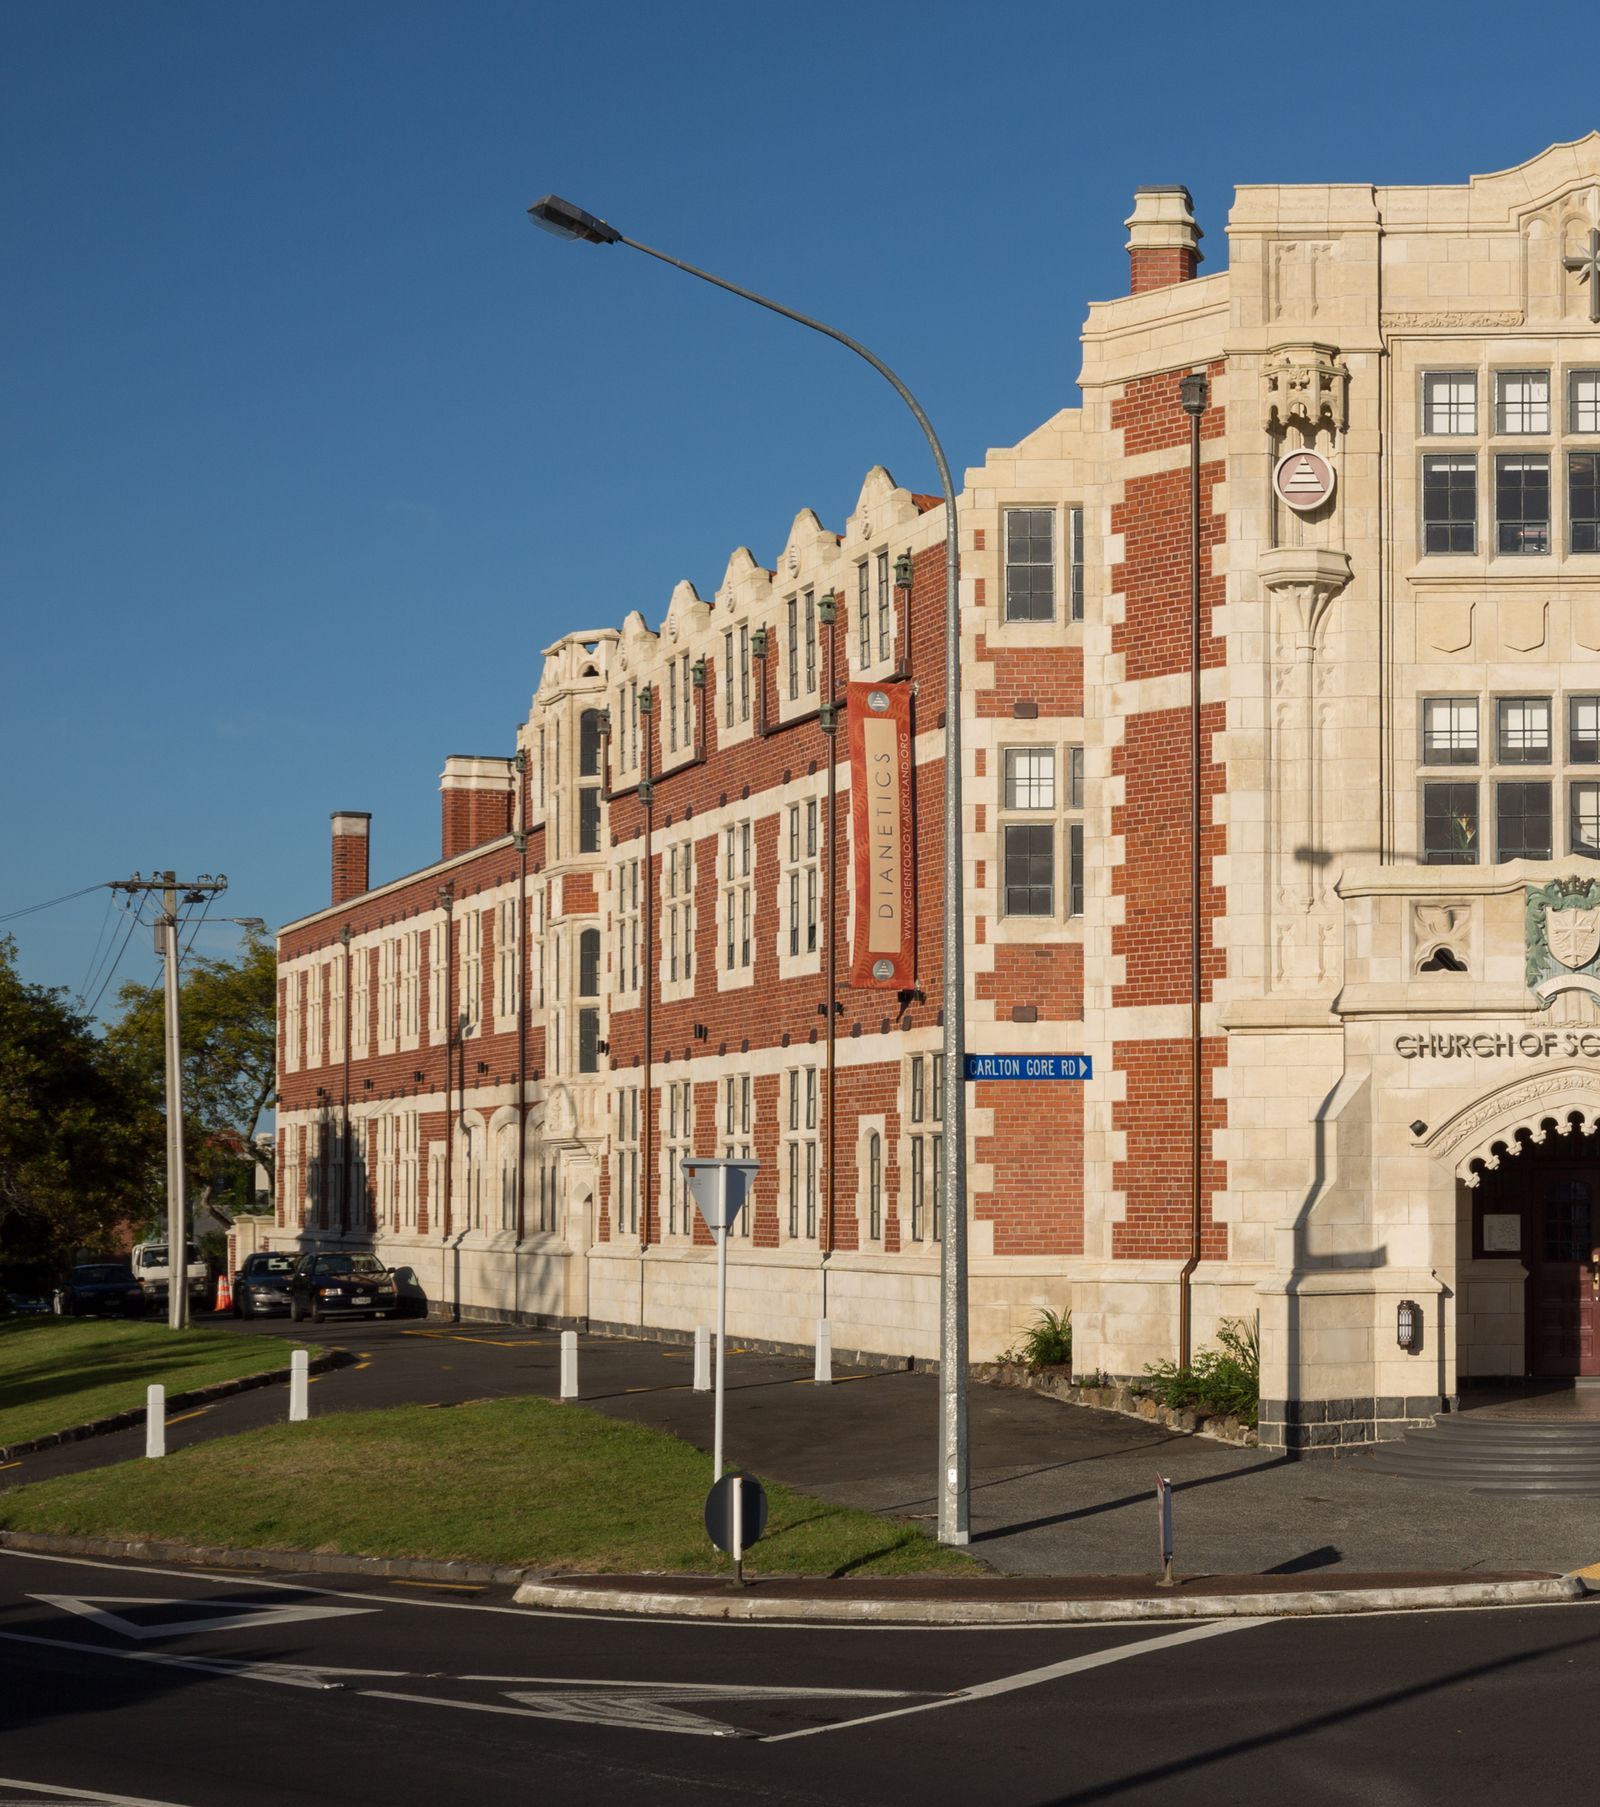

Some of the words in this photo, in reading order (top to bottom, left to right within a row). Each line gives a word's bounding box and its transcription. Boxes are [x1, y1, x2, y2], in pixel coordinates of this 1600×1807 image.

[874, 752, 893, 919] DIANETICS
[1393, 1031, 1514, 1059] CHURCH
[1517, 1031, 1558, 1058] OF
[969, 1059, 1020, 1076] CARLTON
[1026, 1059, 1055, 1076] GORE
[1061, 1059, 1076, 1076] RD
